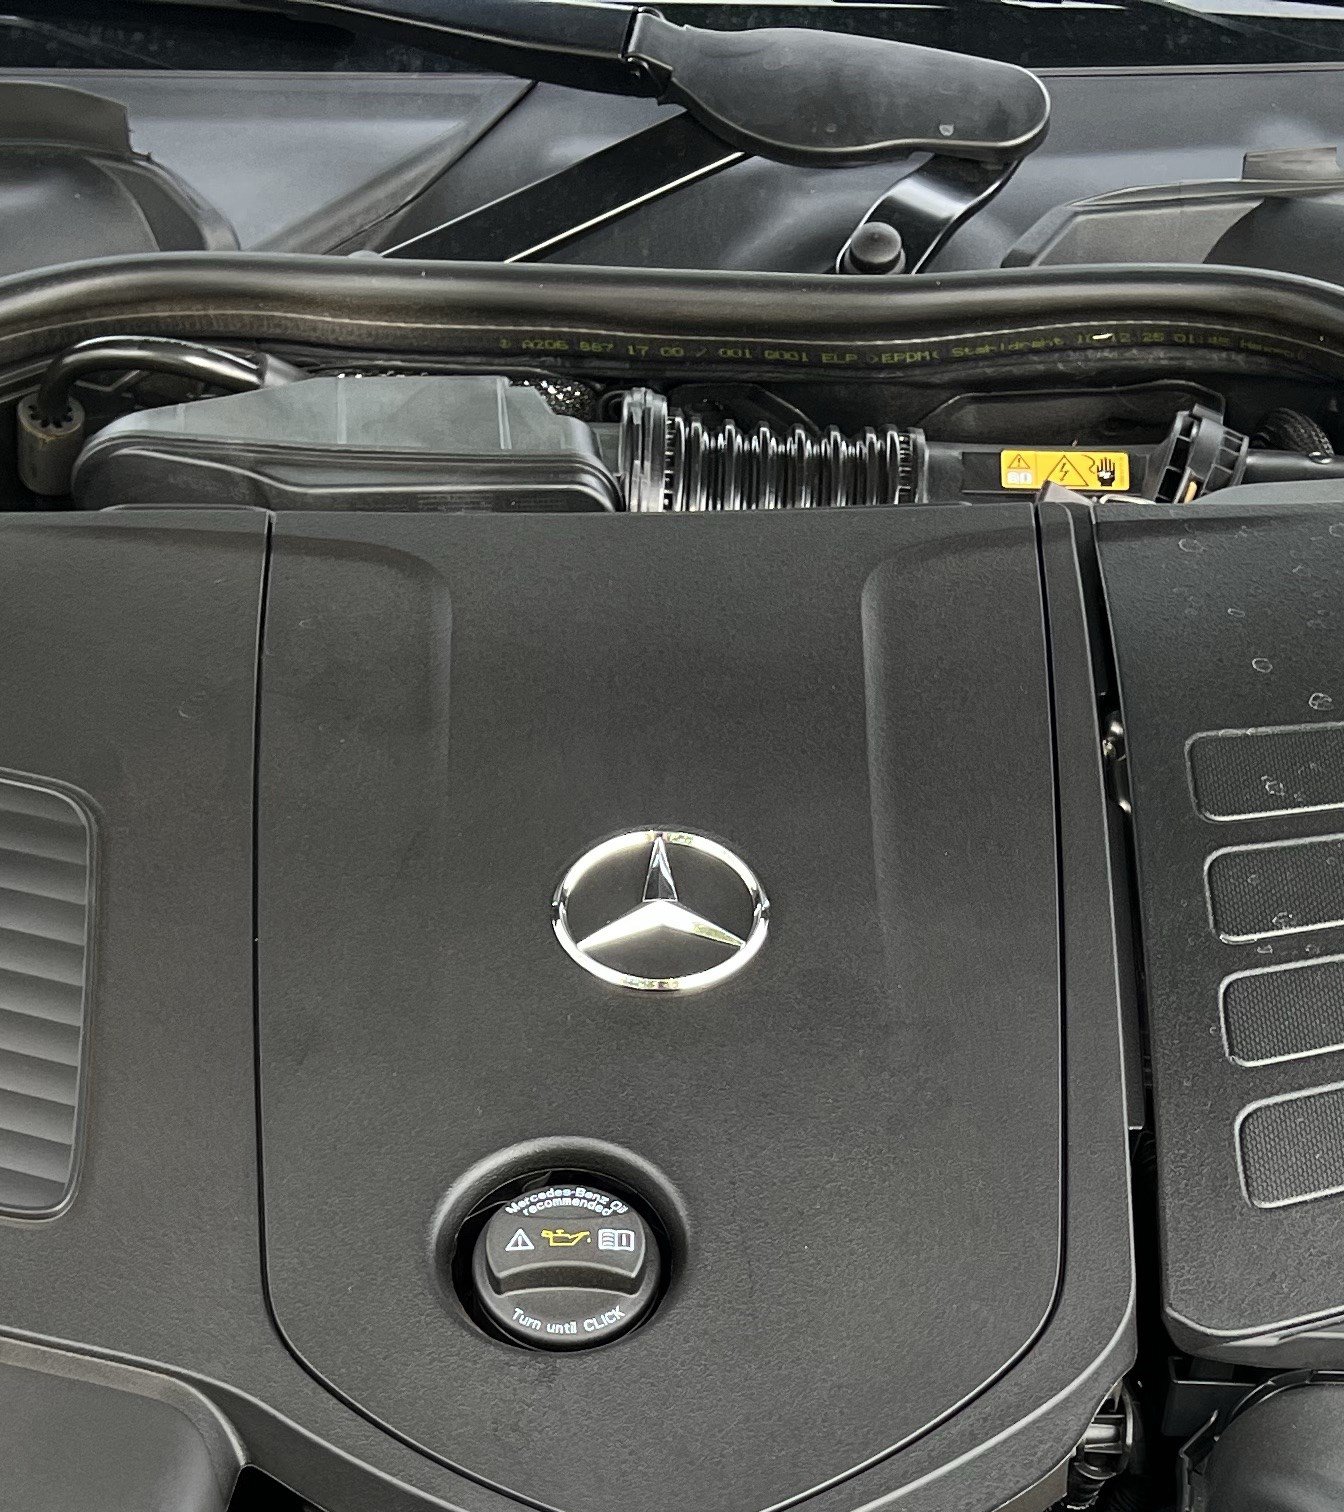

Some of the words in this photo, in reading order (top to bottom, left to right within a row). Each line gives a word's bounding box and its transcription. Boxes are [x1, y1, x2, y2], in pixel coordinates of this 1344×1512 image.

[505, 1187, 612, 1215] Mercedes-Benz
[610, 1200, 630, 1215] Oil
[522, 1197, 612, 1216] recommended
[512, 1307, 542, 1331] Turn
[546, 1321, 577, 1334] until
[583, 1306, 626, 1332] CLICK
